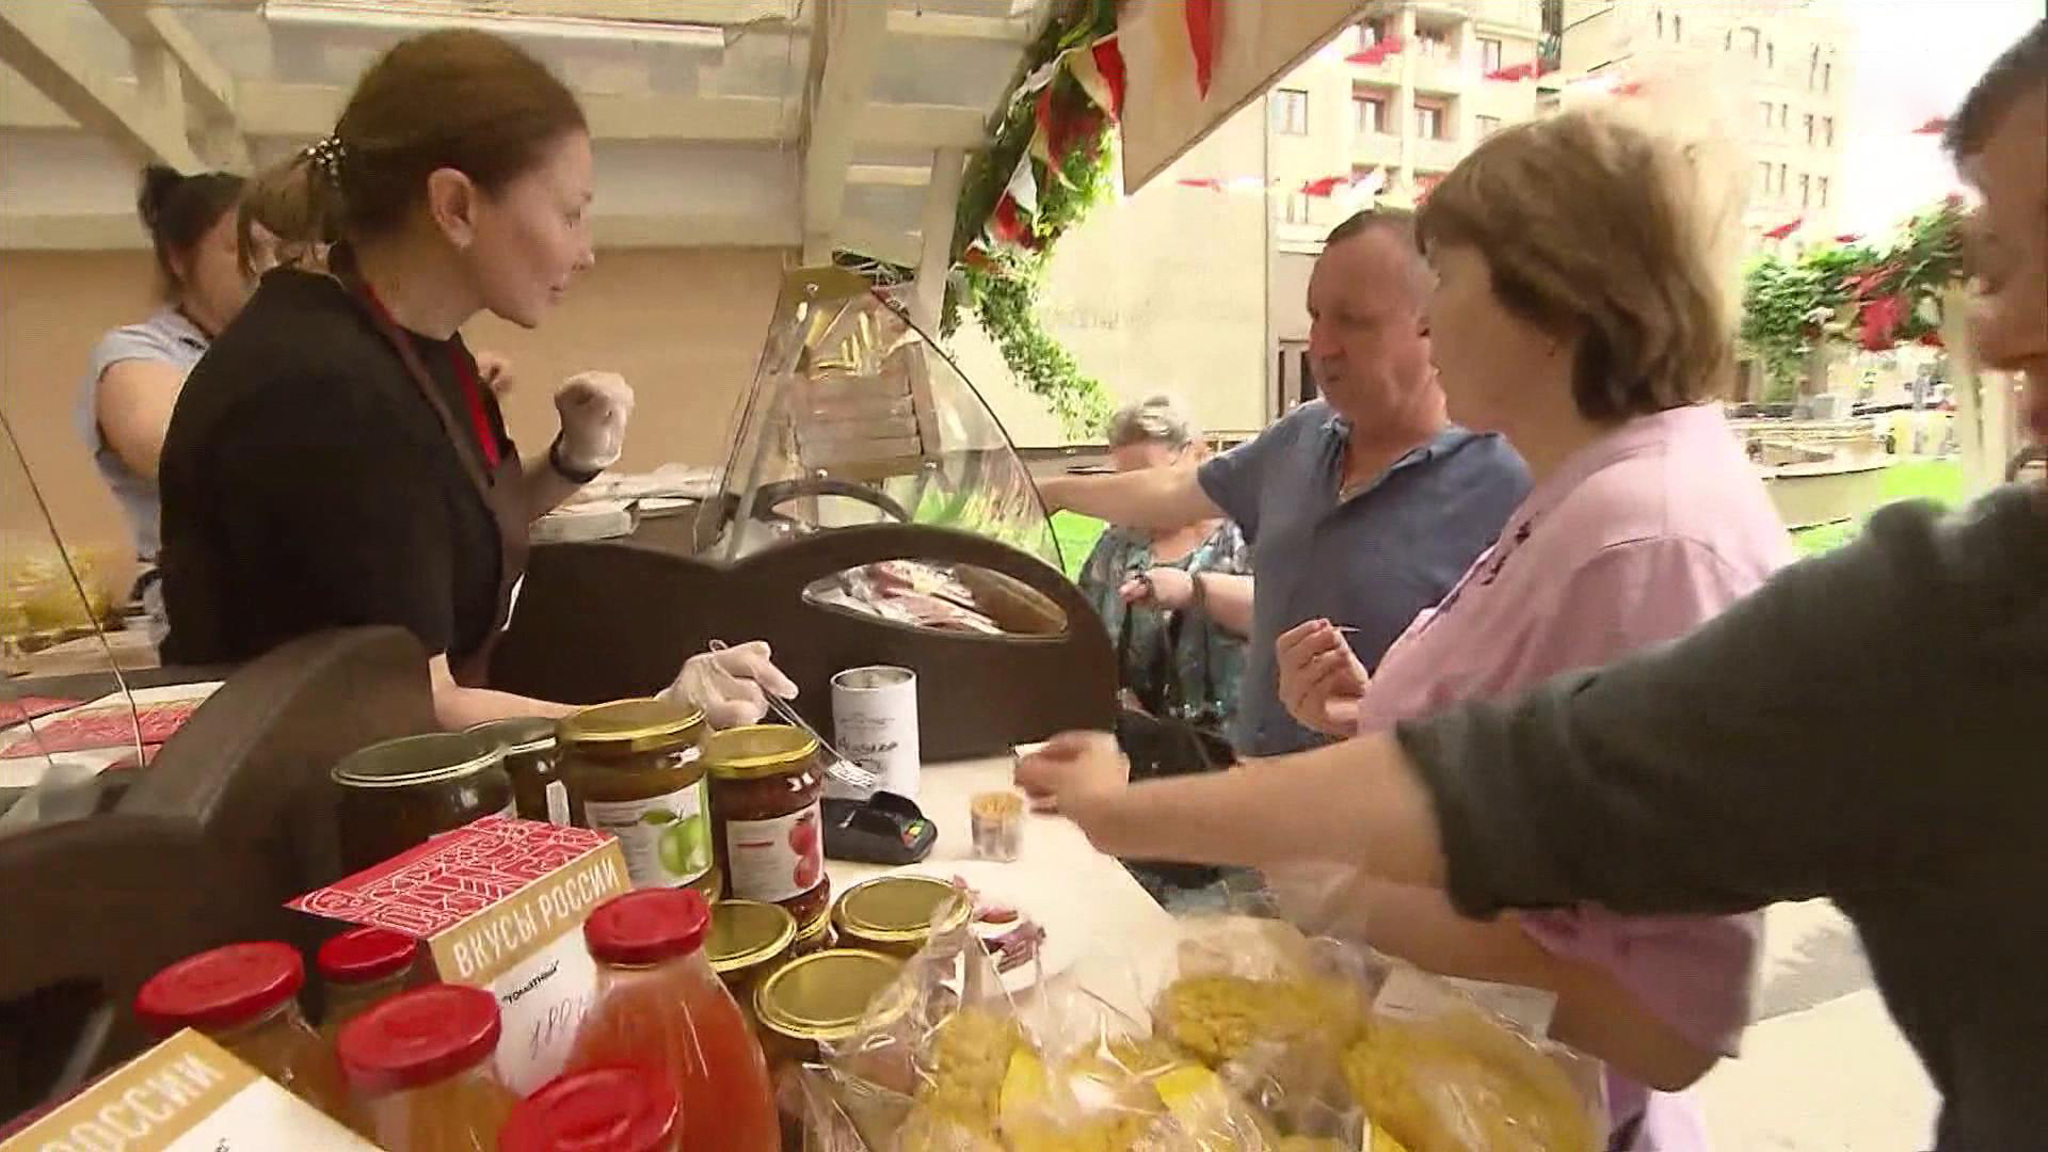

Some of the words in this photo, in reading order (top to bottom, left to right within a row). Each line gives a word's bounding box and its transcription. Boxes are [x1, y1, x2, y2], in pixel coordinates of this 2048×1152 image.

[453, 903, 537, 978] ВКУСЫ
[538, 857, 621, 925] РОССИИ
[41, 1052, 225, 1152] ОССИИ
